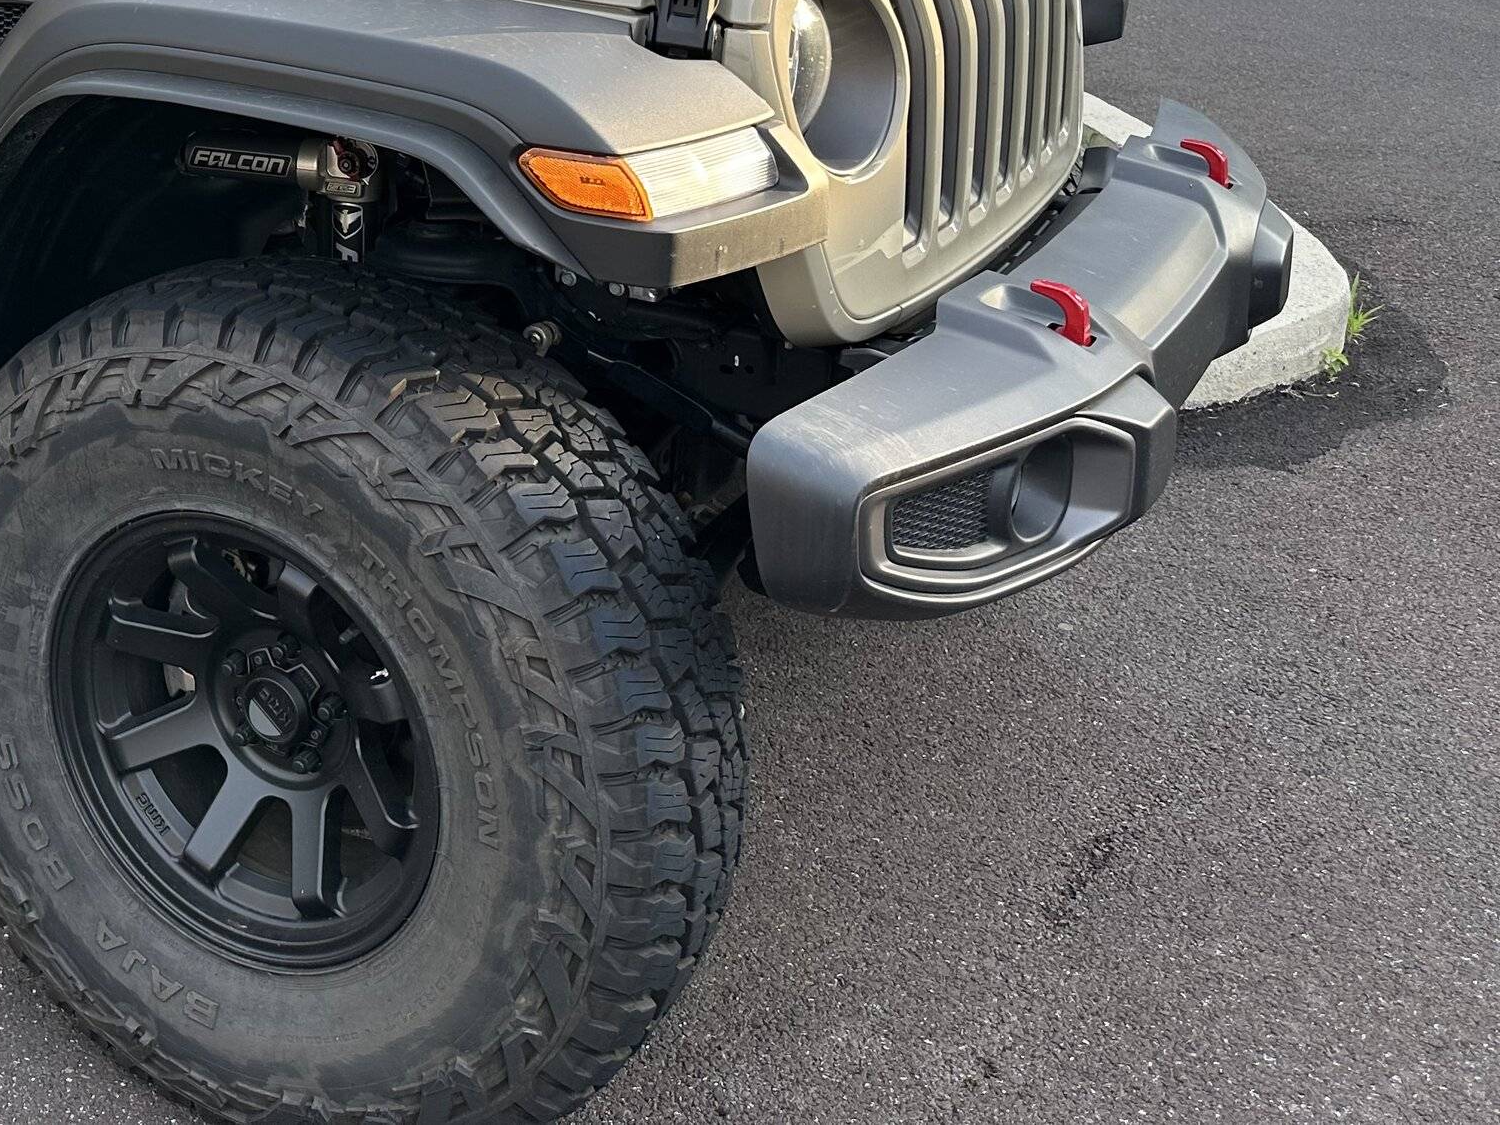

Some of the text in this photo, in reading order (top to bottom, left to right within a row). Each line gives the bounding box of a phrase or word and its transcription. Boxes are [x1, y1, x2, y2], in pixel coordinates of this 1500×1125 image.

[193, 149, 286, 174] FALCON
[149, 448, 325, 517] MICKEY
[360, 541, 501, 851] THOMPSON
[96, 917, 221, 1030] BAJA
